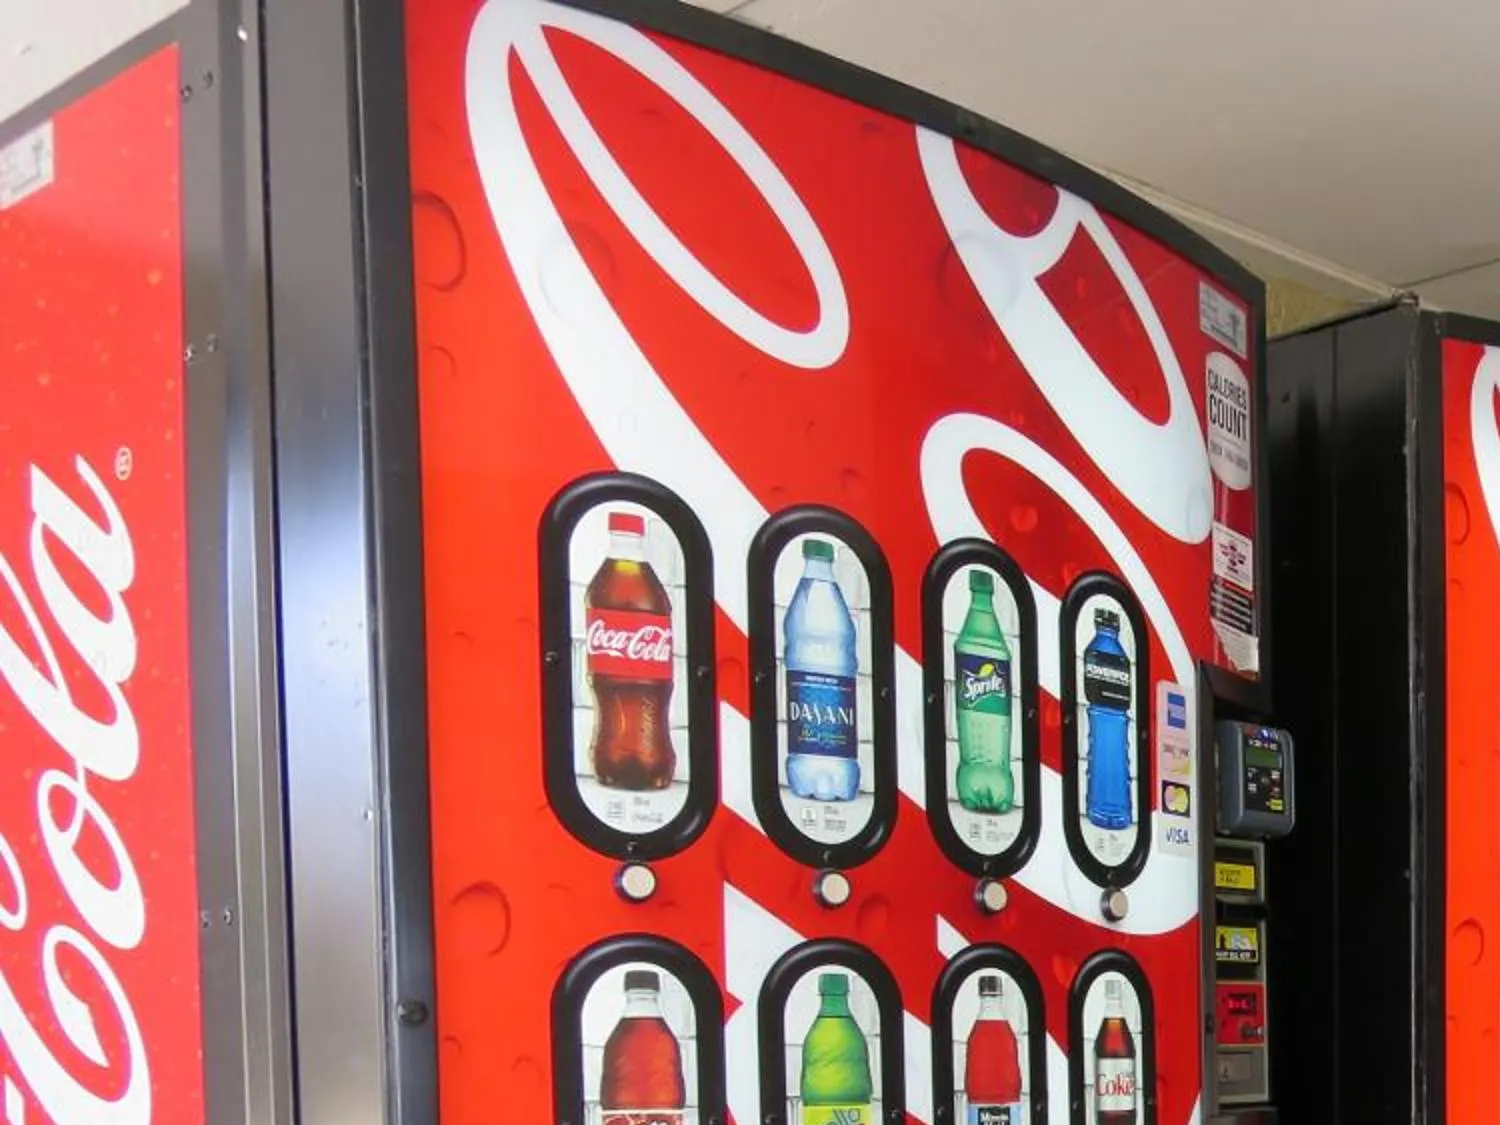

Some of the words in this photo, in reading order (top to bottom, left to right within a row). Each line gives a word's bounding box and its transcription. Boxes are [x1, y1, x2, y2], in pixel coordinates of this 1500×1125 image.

[1208, 367, 1247, 411] CALORIES
[1210, 393, 1247, 441] COUNT
[587, 620, 672, 662] Coca-Cola
[964, 676, 1006, 701] Sprite
[790, 702, 854, 727] DASANI
[1166, 827, 1190, 845] VISA
[1096, 1073, 1135, 1097] Coke
